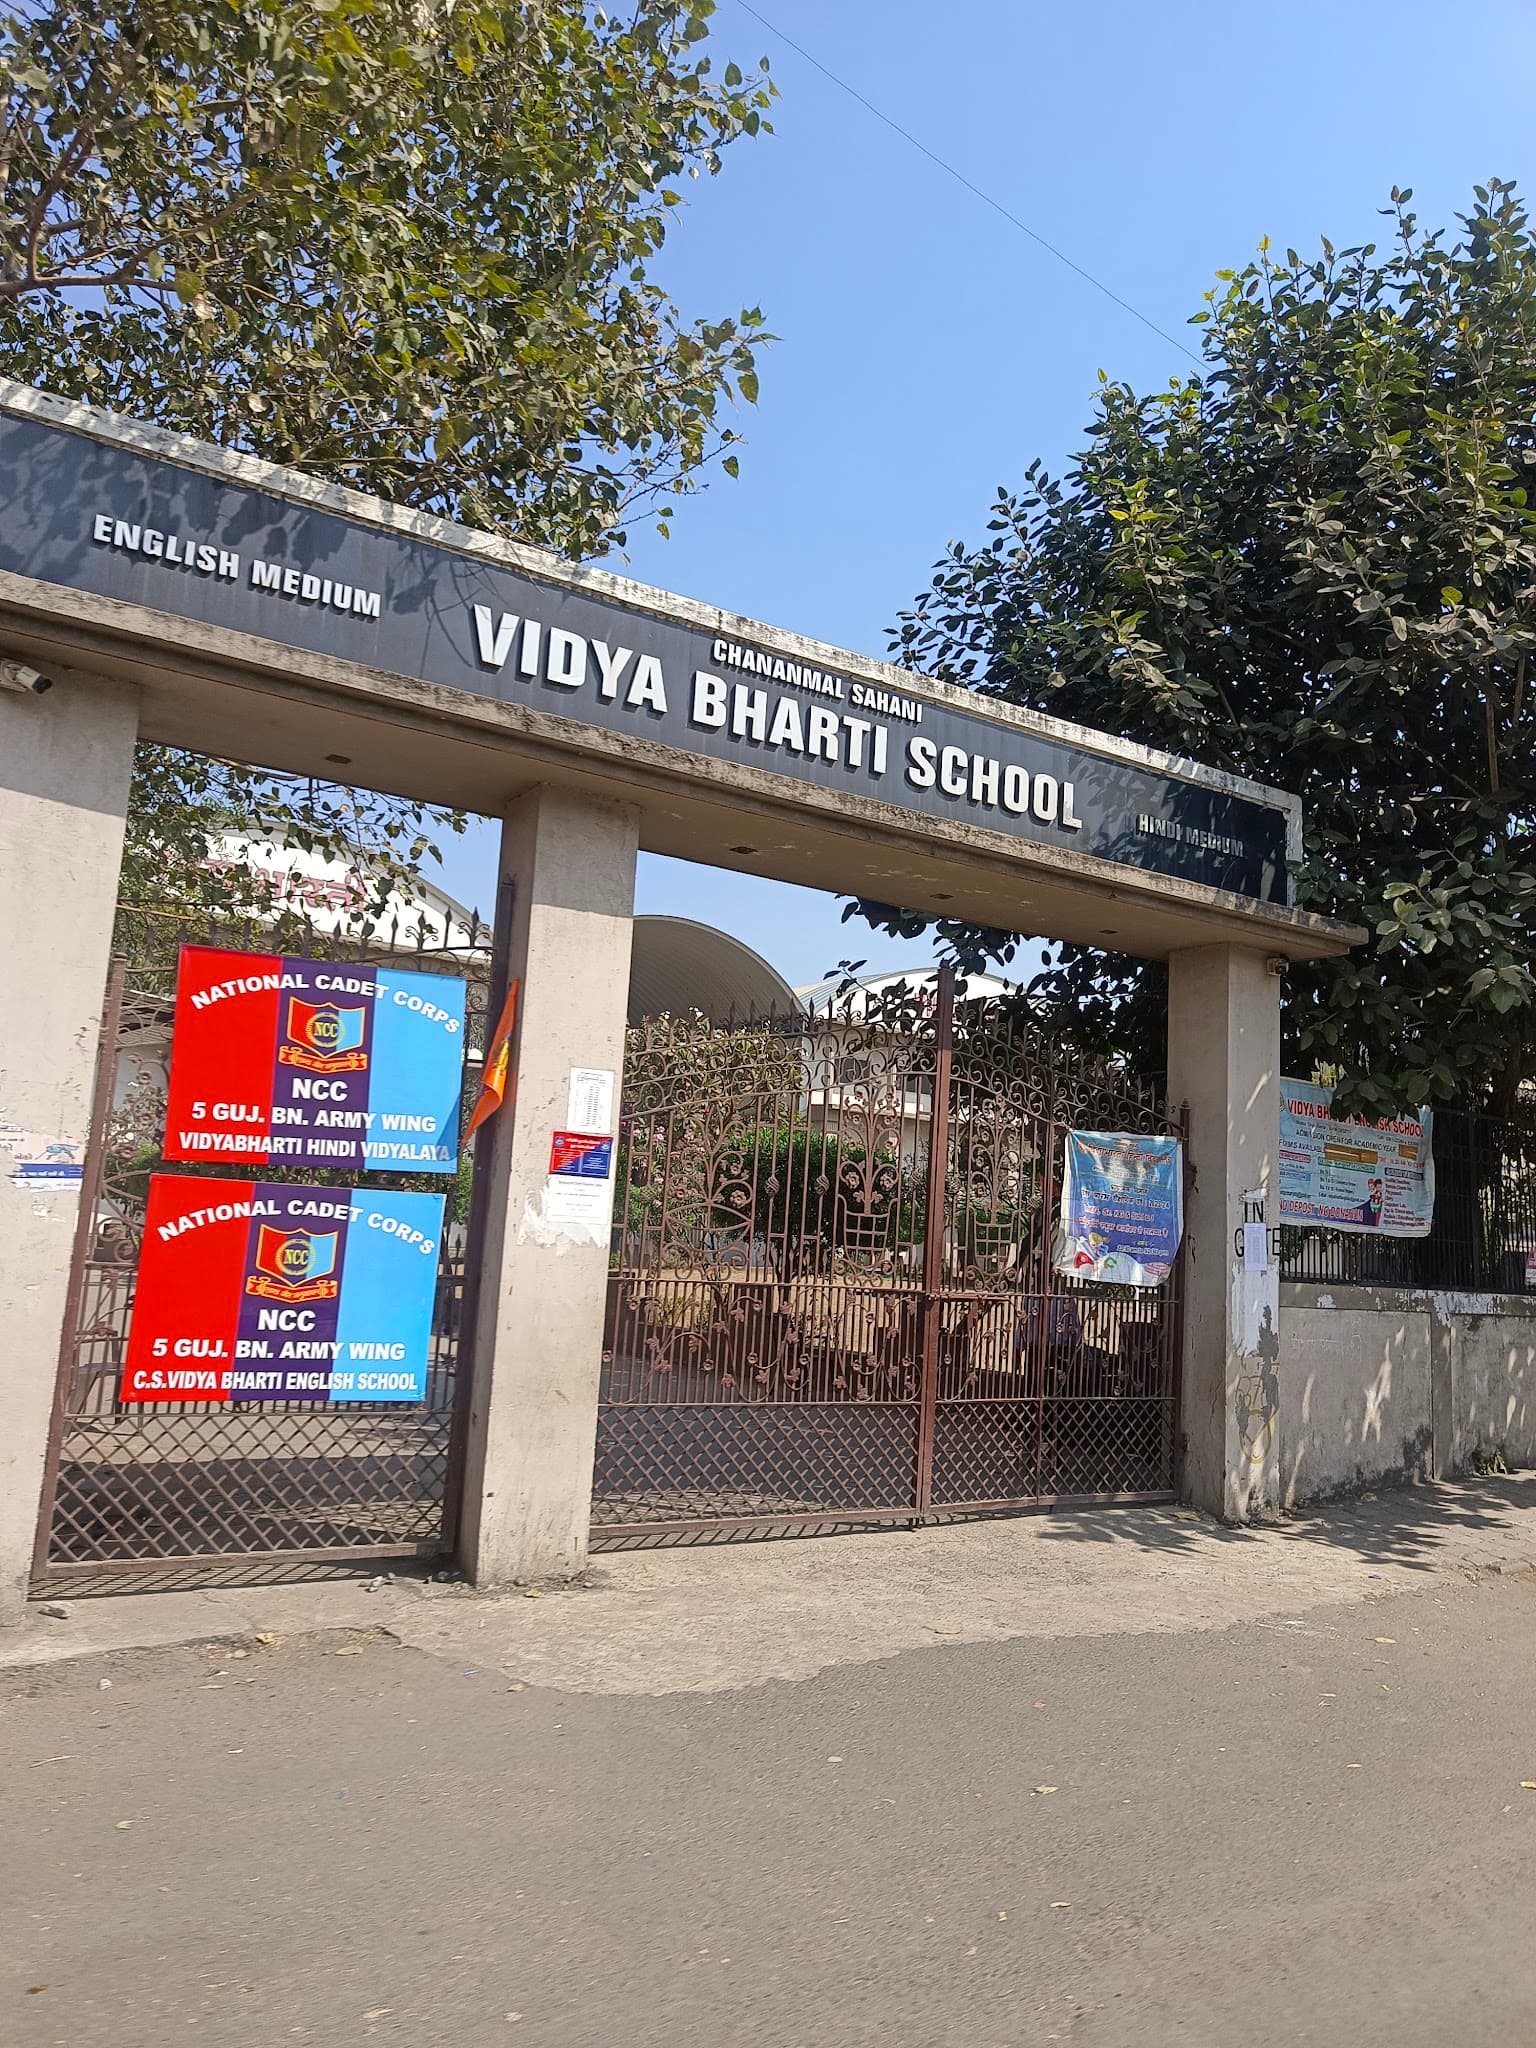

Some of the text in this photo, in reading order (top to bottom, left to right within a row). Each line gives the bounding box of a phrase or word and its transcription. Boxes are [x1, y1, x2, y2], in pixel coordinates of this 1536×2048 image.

[93, 513, 381, 618] ENGLISH MEDIUM
[713, 638, 924, 723] CHANANMAL SAHANI
[473, 604, 1084, 830] VIDYA BHARTI SCHOOL
[1139, 813, 1244, 857] HINDI MEDIUM
[190, 974, 461, 1034] NATIONAL CADET CORPS
[314, 1021, 338, 1038] NCC
[292, 1078, 348, 1101] NCC
[192, 1102, 437, 1133] 5 GUJ. BN. ARMY WING
[1287, 1099, 1315, 1118] VIDYA
[178, 1131, 449, 1161] VIDYABHARTI HINDI VIDYALAYA
[157, 1200, 436, 1255] NATIONAL CADET CORPS
[283, 1249, 309, 1265] NCC
[257, 1309, 315, 1331] NCC
[152, 1338, 406, 1360] 5 GUJ. BN. ARMY WING
[133, 1370, 418, 1390] C.S.VIDYA BHARTI ENGLISH SCHOOL
